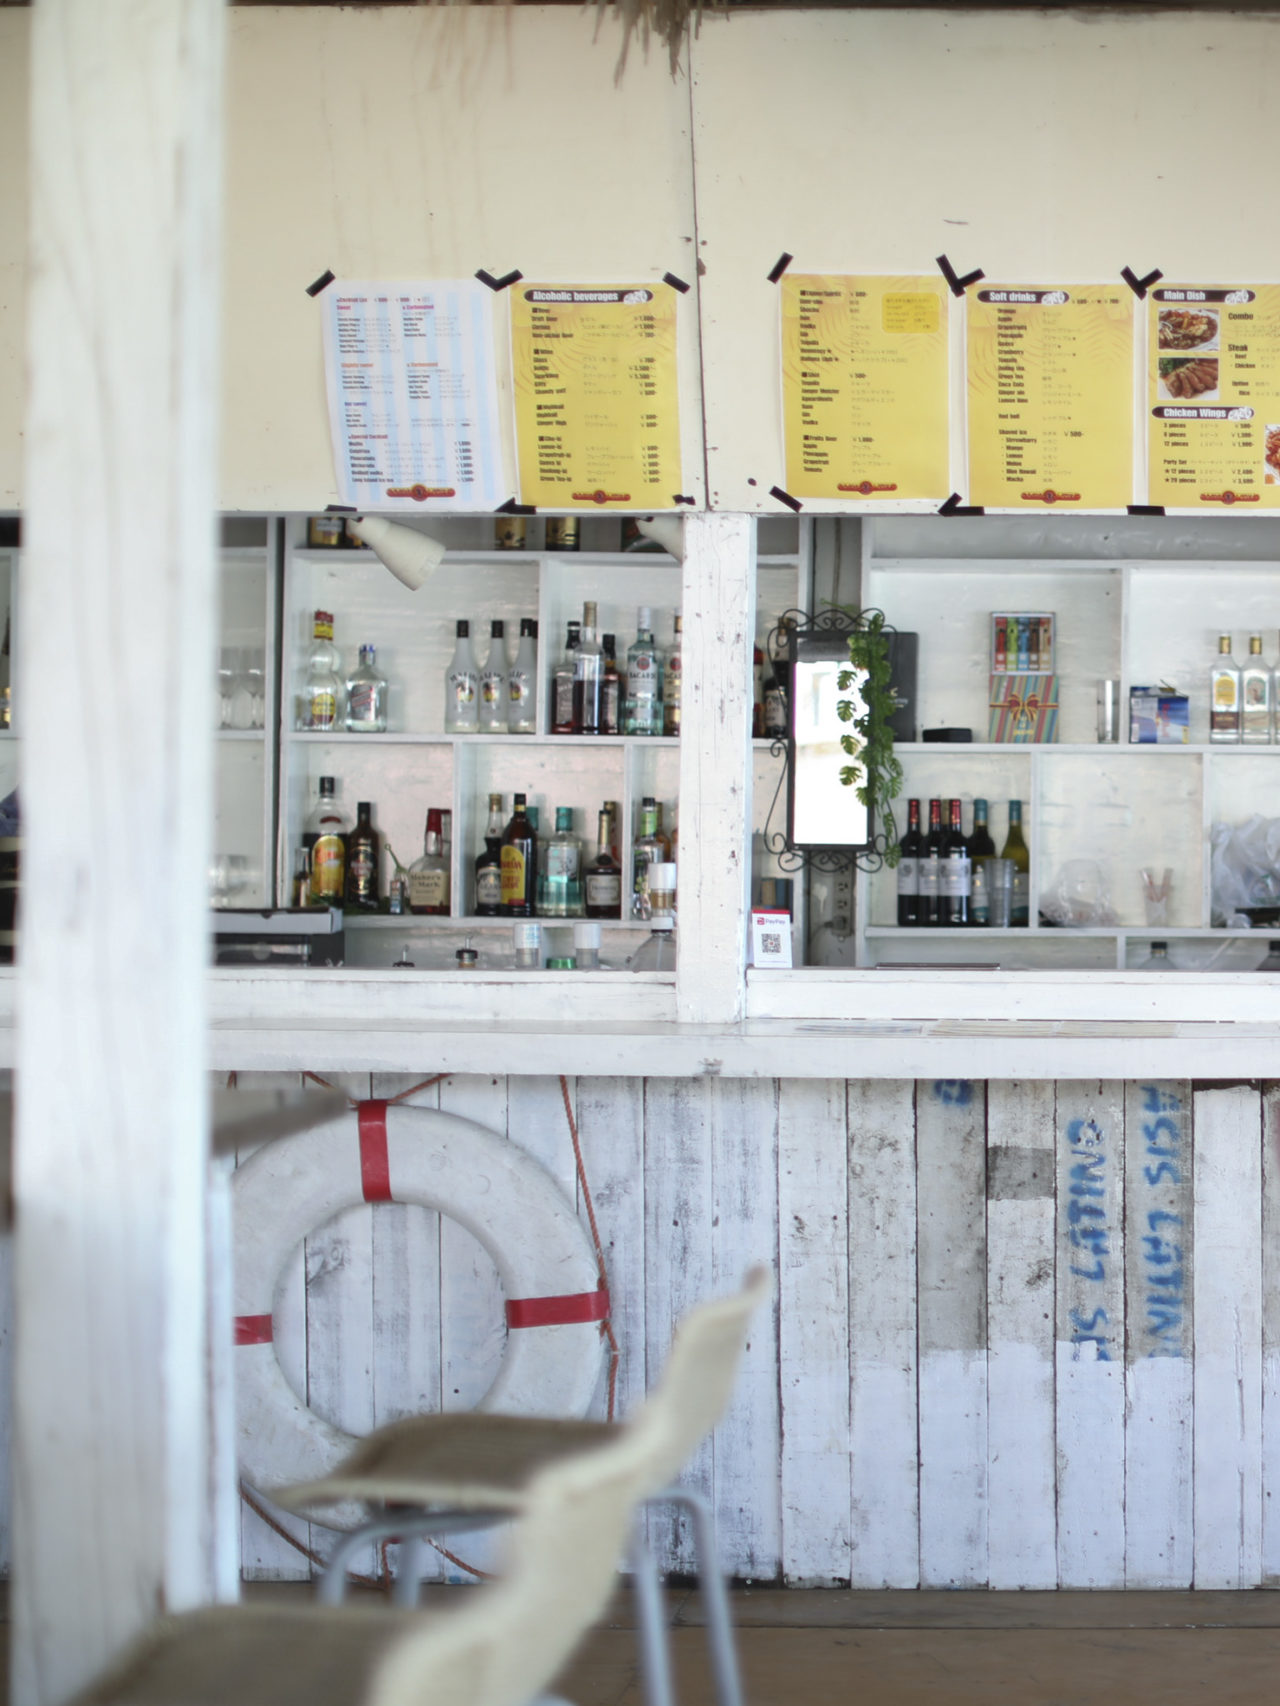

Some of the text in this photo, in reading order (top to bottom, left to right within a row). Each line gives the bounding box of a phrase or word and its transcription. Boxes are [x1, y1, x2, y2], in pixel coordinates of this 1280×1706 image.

[533, 291, 619, 303] Alcoholic beverages
[989, 292, 1036, 302] Soft drinks
[1163, 291, 1206, 301] Main Dish
[1228, 313, 1254, 321] Combo
[1228, 344, 1248, 352] Steak
[1163, 408, 1227, 419] Chicken Wings
